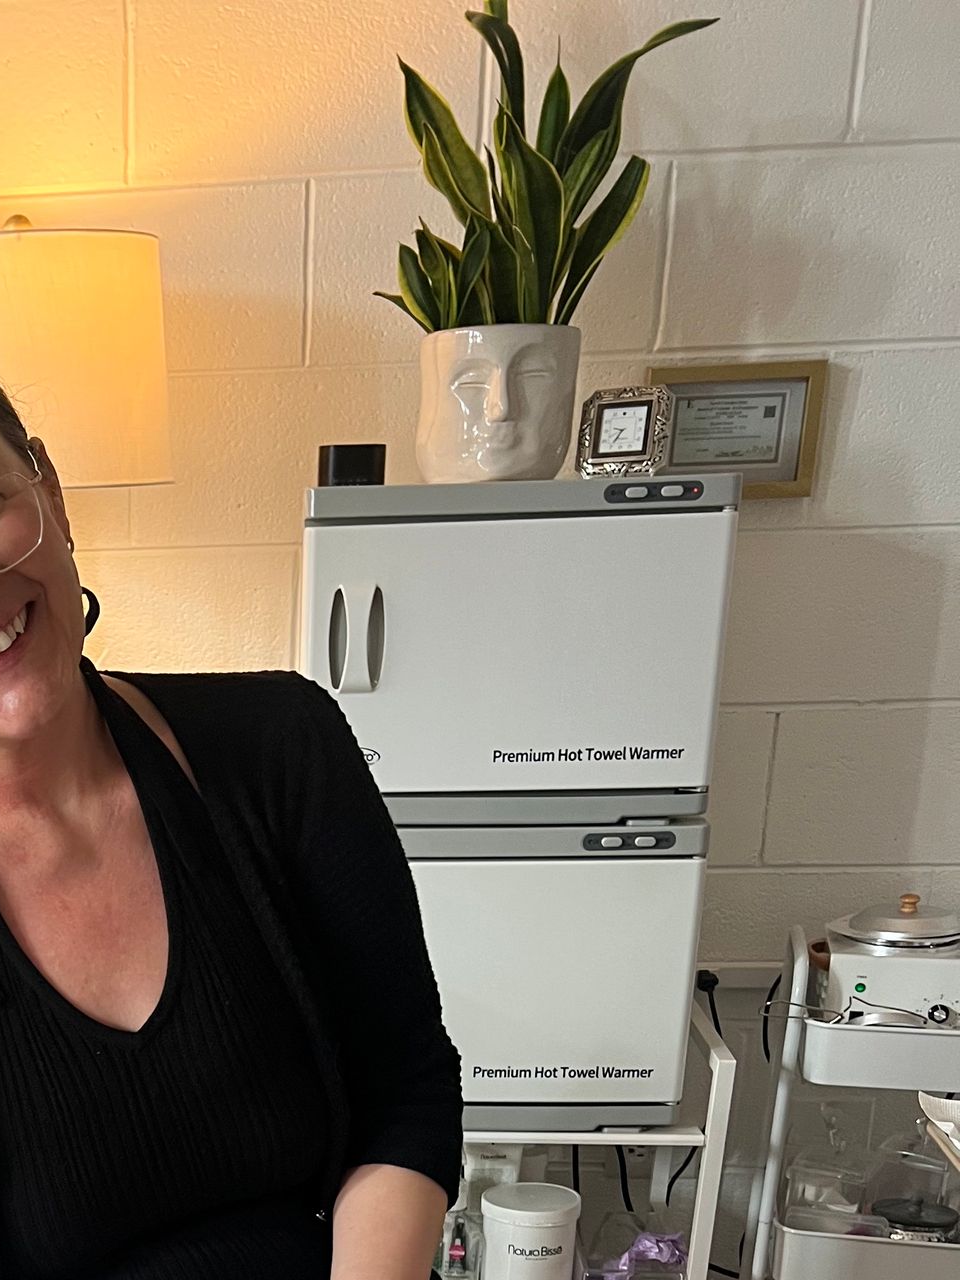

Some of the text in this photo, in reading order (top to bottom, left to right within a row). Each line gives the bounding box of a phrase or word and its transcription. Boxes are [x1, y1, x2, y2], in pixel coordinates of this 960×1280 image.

[493, 746, 685, 763] Premium Hot Towel Warmer
[473, 1065, 655, 1079] Premium Hot Towel Warmer
